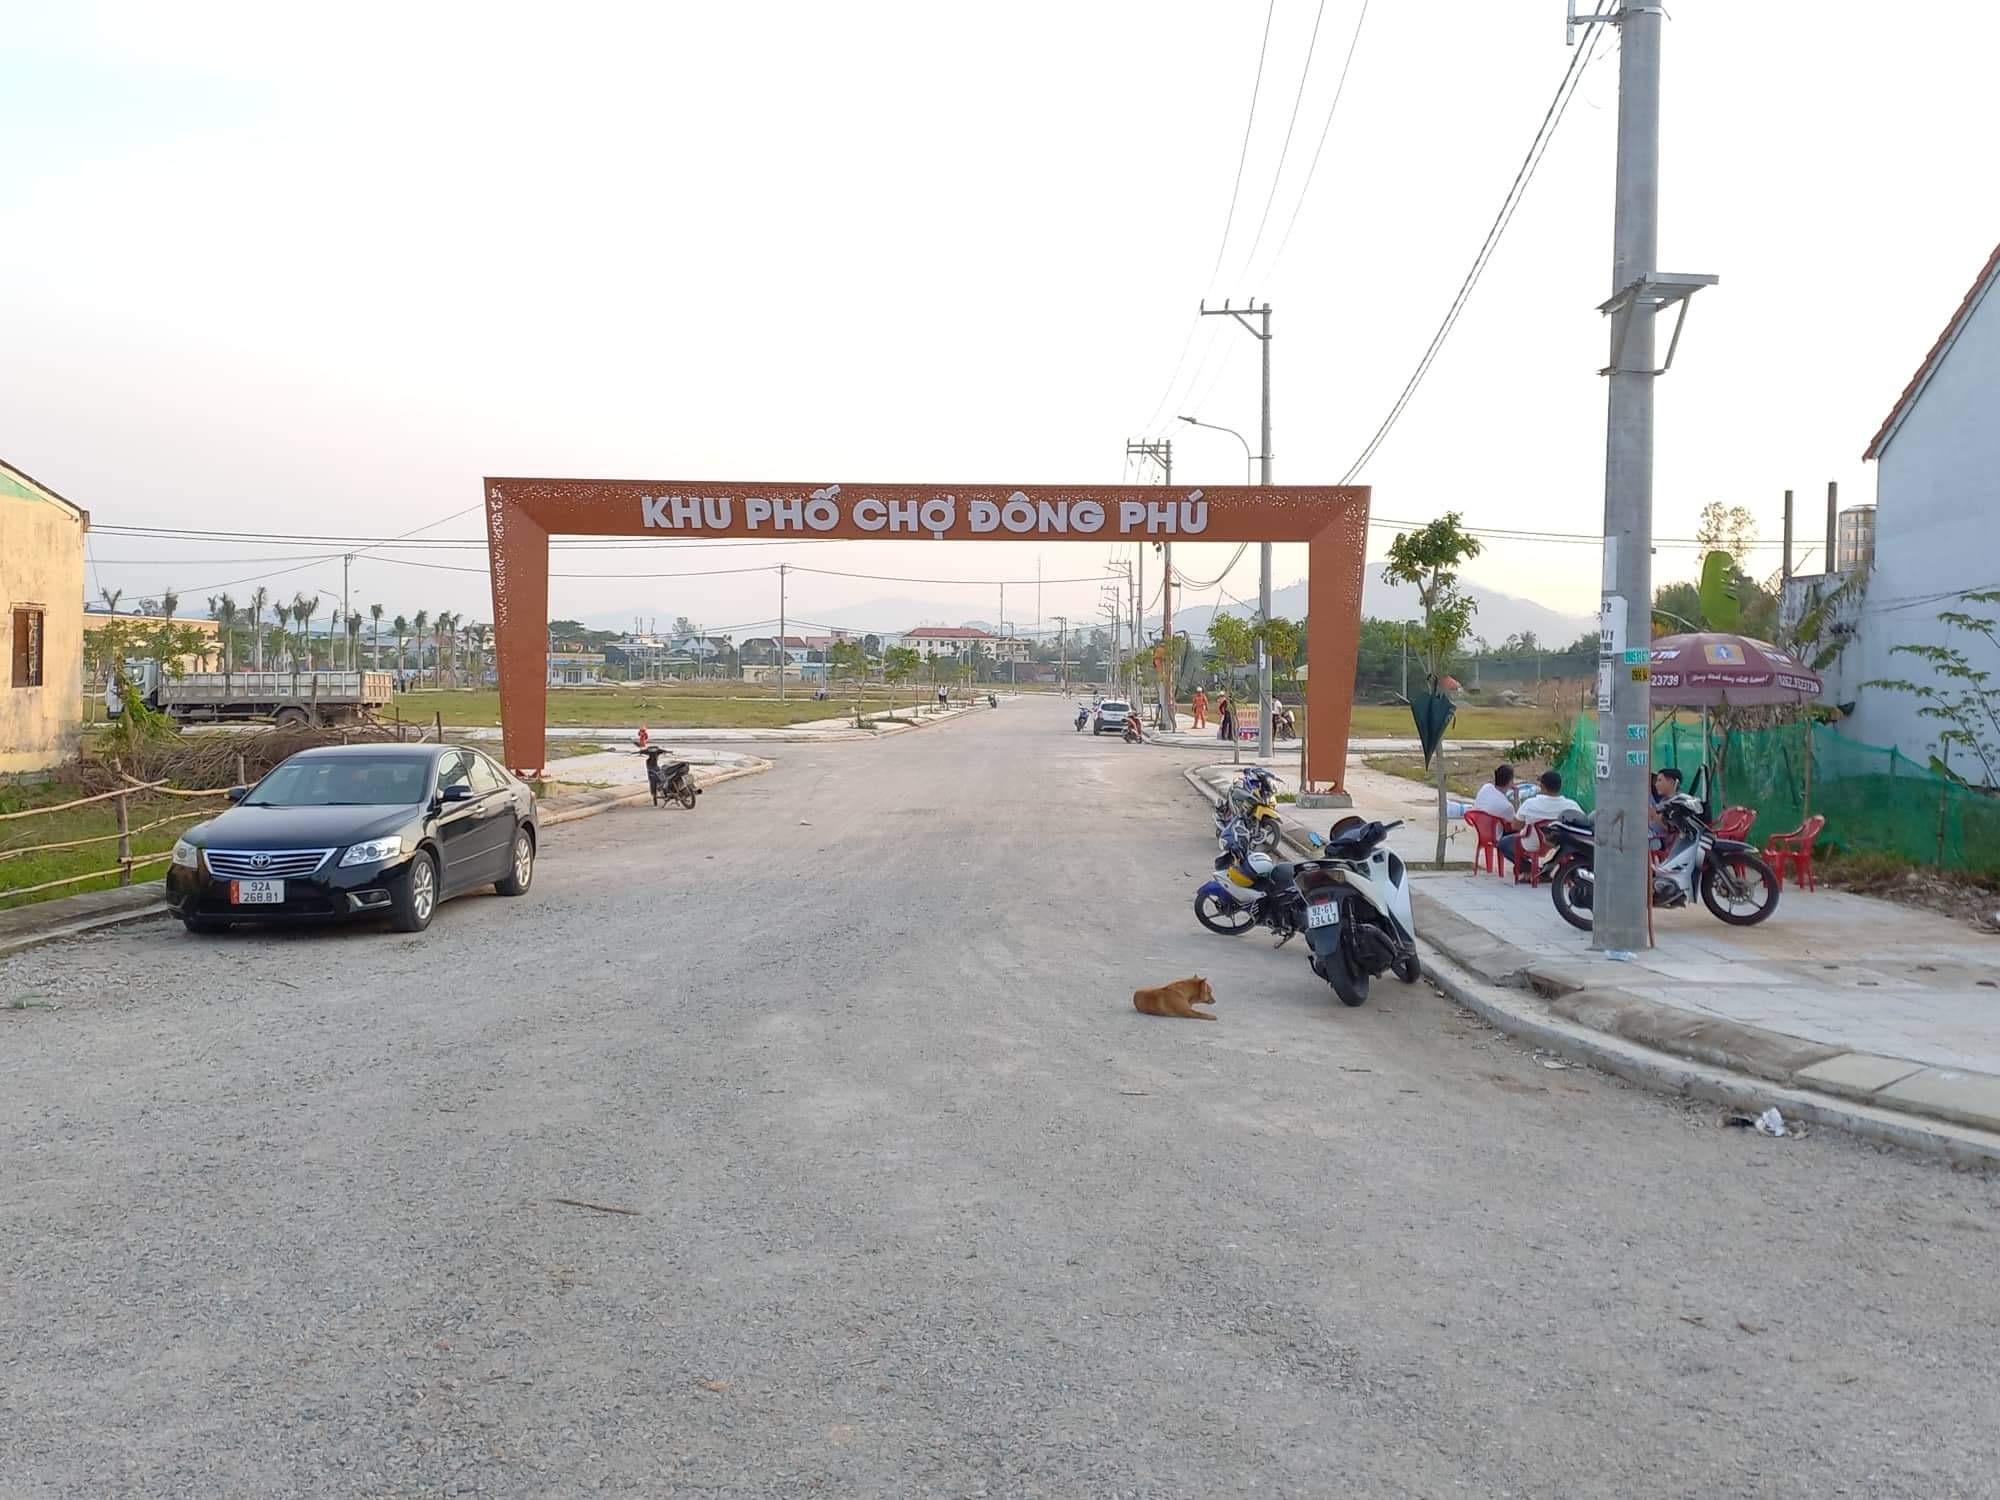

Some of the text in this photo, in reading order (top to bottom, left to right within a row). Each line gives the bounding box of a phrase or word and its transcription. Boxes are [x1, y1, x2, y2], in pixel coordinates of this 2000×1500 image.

[641, 484, 1209, 540] KHU PHỐ CHỢ ĐÔNG PHÚ
[251, 881, 271, 892] 92A
[243, 892, 278, 903] 268.81
